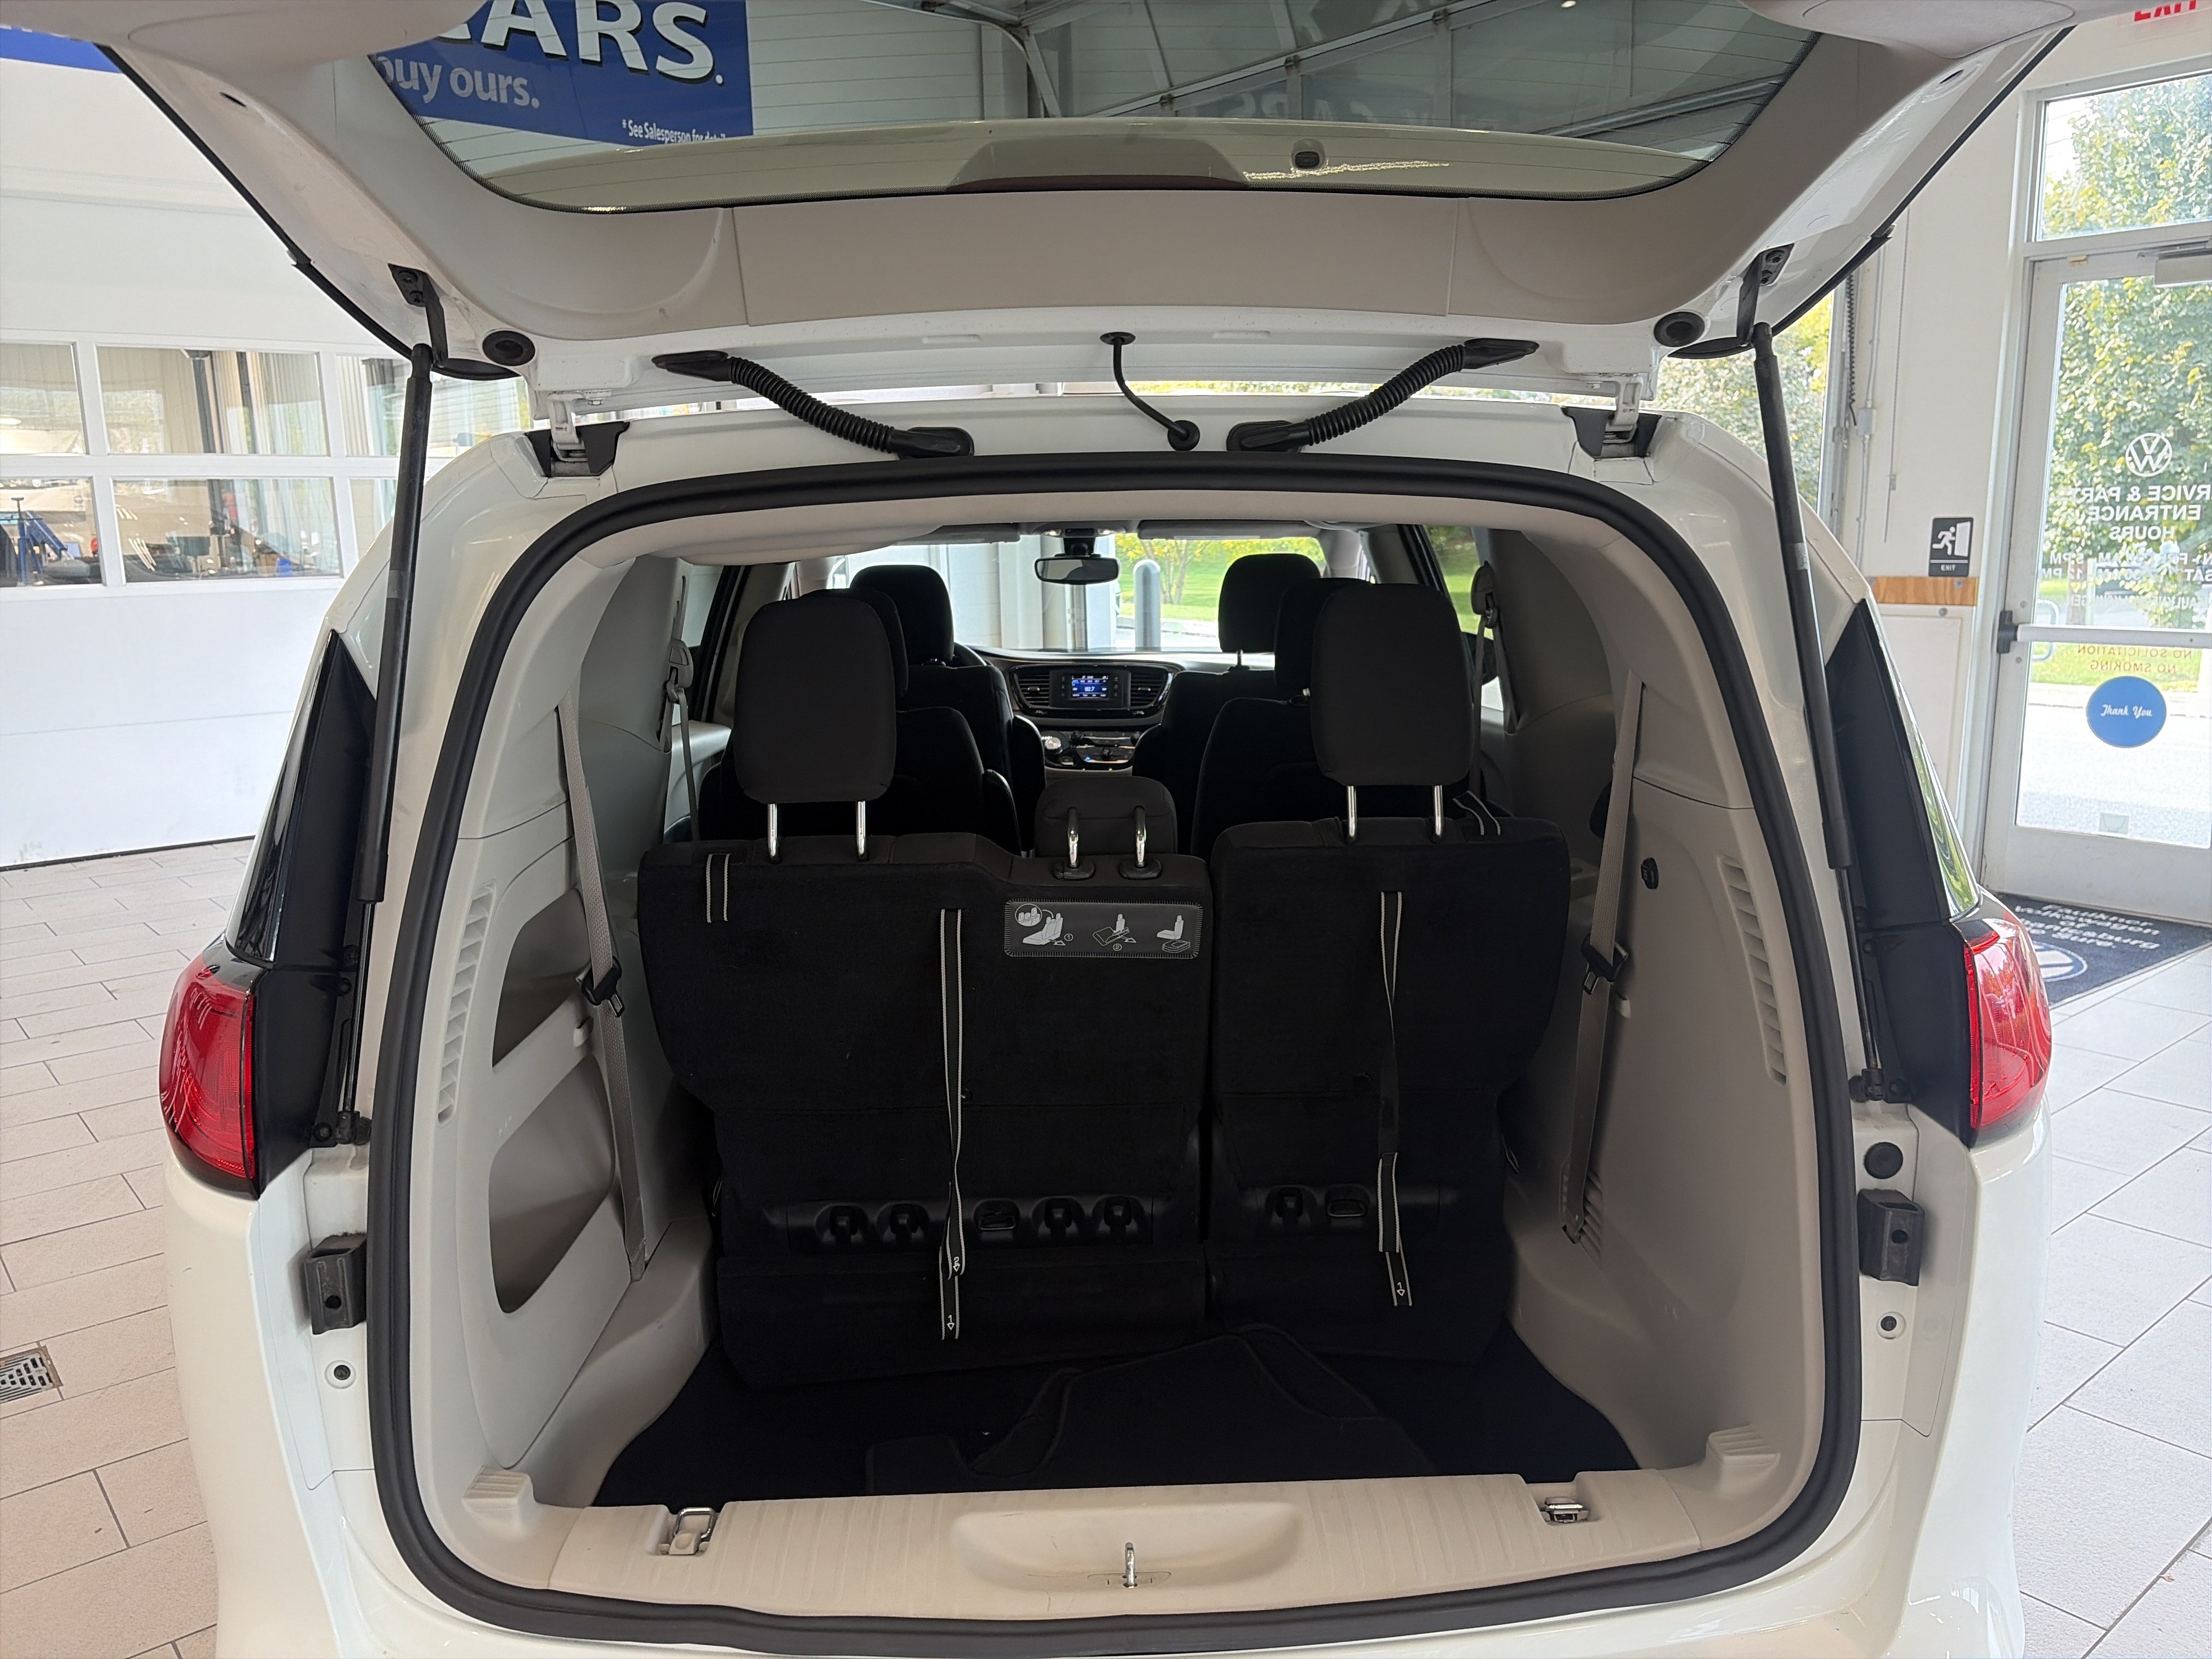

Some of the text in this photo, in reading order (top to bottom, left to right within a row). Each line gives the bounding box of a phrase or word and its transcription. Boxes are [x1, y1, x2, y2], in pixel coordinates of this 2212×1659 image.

[437, 0, 724, 84] ARS.
[449, 66, 540, 109] ours.
[644, 122, 690, 144] Salesperson
[2100, 704, 2153, 719] Thank You
[953, 1256, 960, 1265] 2
[948, 1314, 952, 1323] 1
